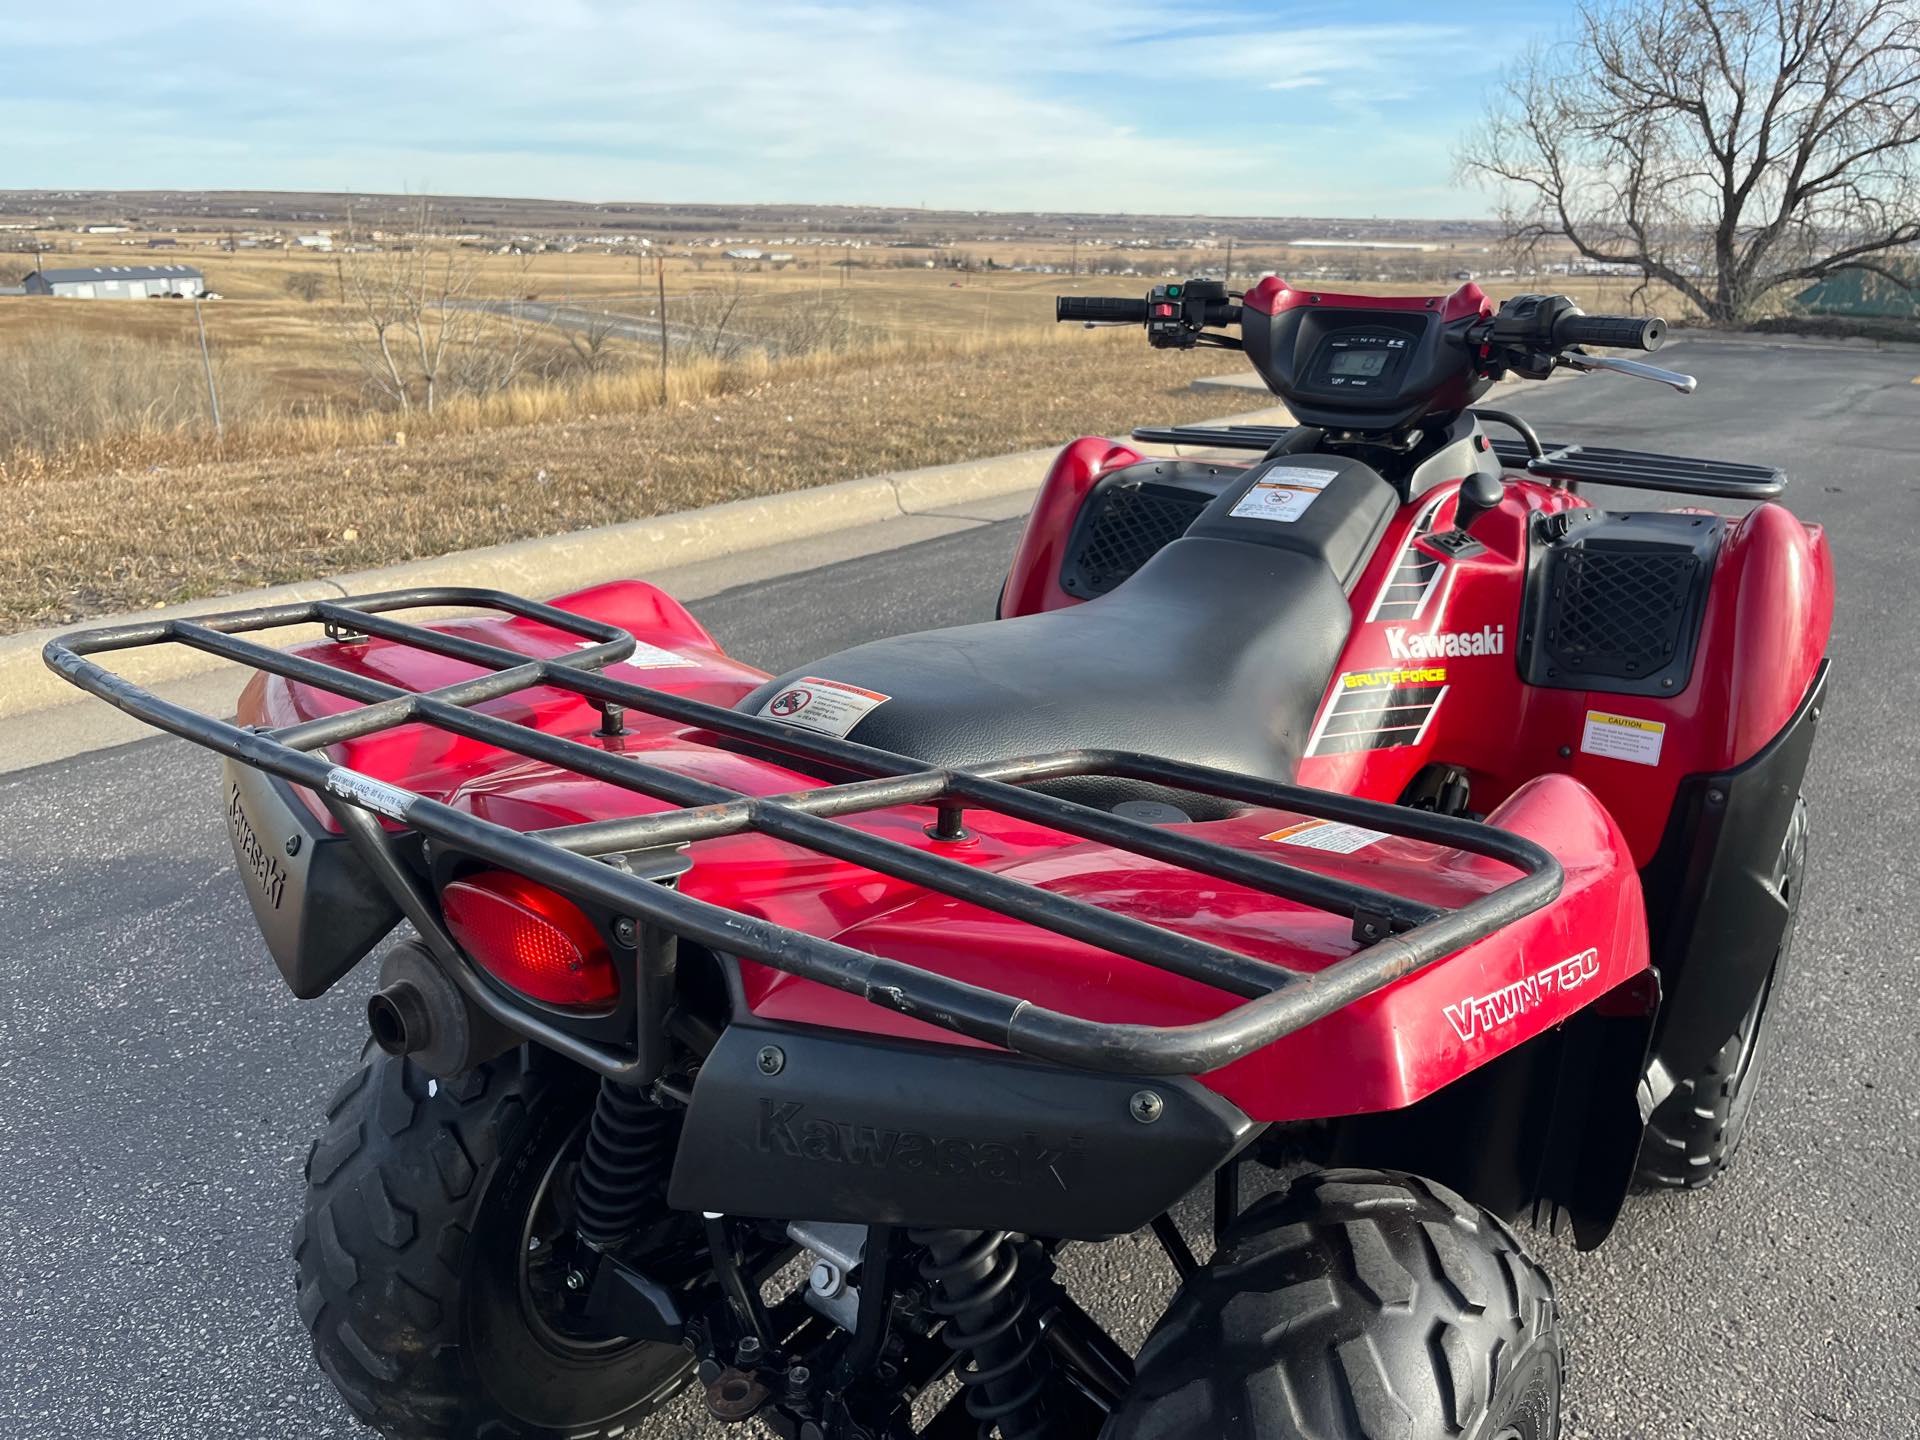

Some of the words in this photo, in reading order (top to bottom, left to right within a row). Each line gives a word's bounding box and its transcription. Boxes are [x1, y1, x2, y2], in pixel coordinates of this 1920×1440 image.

[1384, 624, 1504, 659] Kawasaki
[1607, 716, 1642, 729] CAUTION
[330, 772, 355, 788] MAXIMUM
[229, 783, 286, 909] Kawasaki
[1539, 947, 1599, 990] 750
[759, 1096, 1089, 1191] Kawasaki
